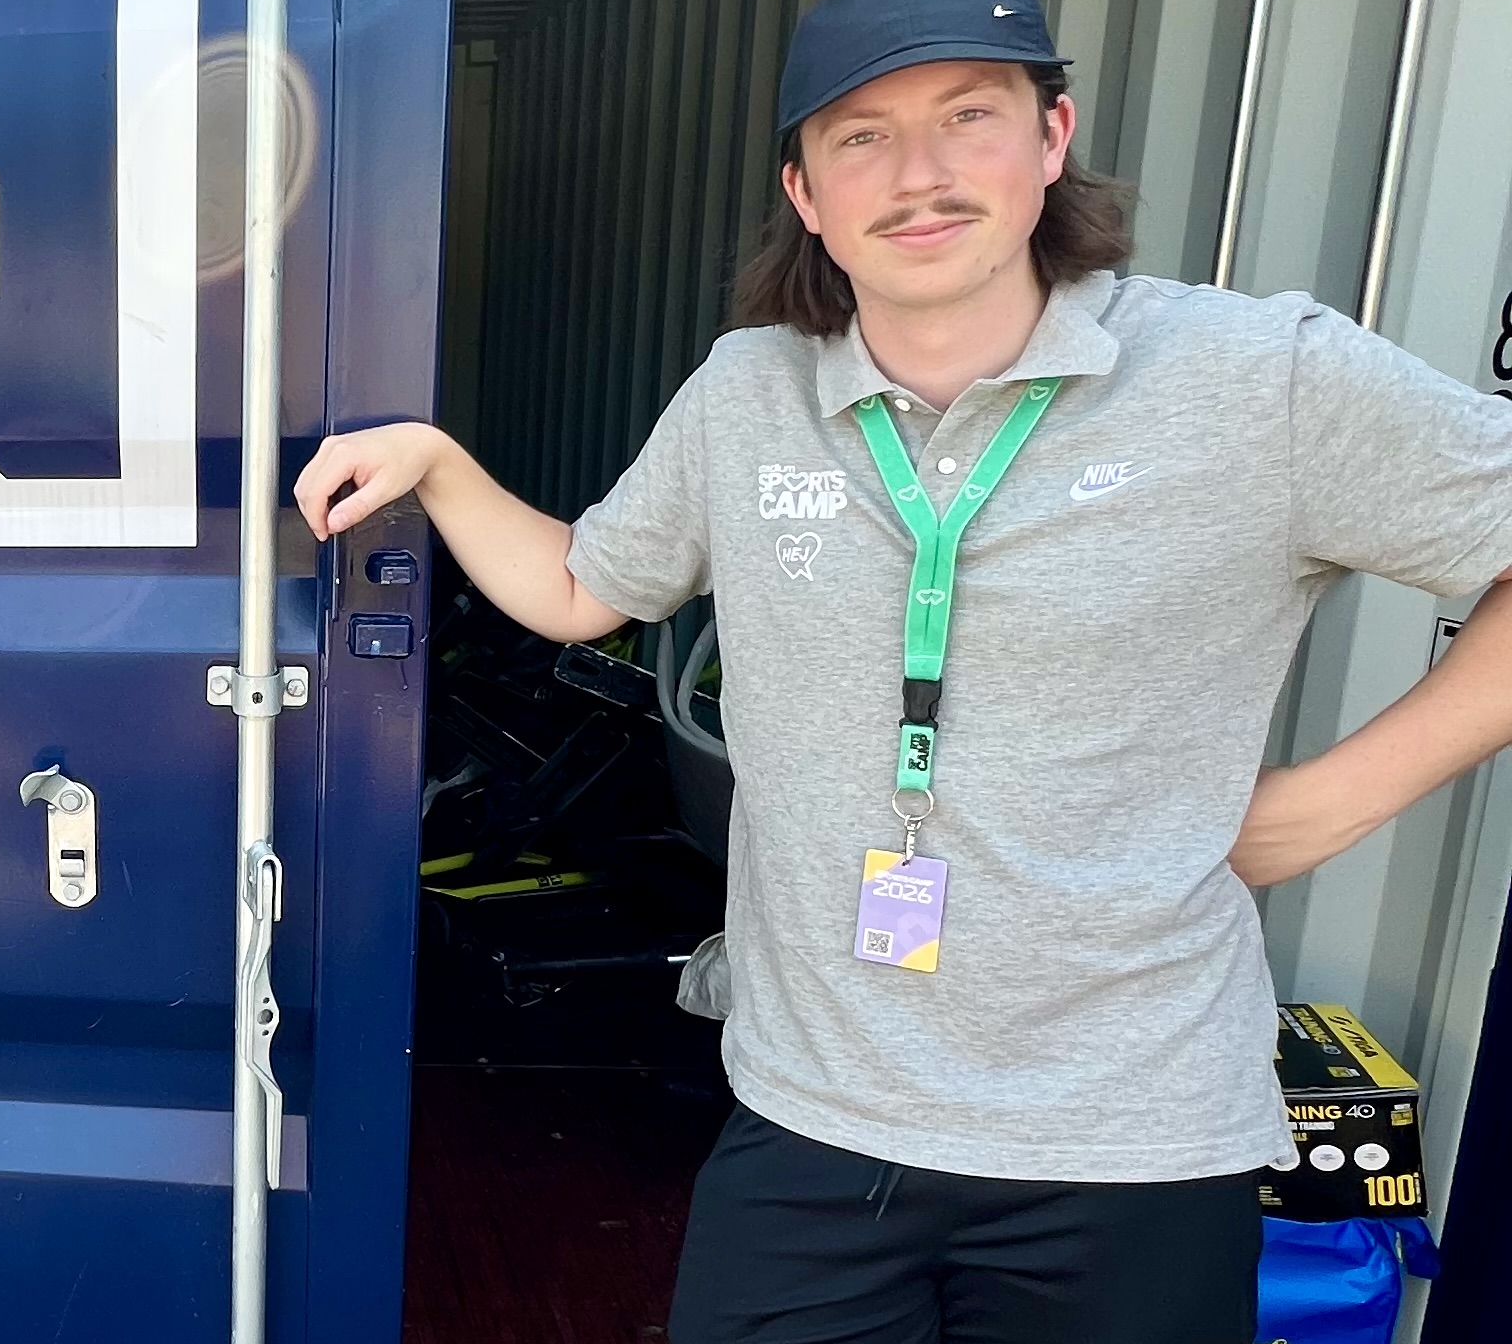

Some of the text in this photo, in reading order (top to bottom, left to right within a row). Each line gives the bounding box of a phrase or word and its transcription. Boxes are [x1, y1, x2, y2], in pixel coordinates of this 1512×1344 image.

[1080, 462, 1132, 487] NIKE
[759, 491, 848, 520] CAMP
[782, 546, 810, 562] HEJ
[872, 879, 933, 905] 2026
[1345, 1104, 1376, 1119] 40
[1363, 1173, 1416, 1207] 100
